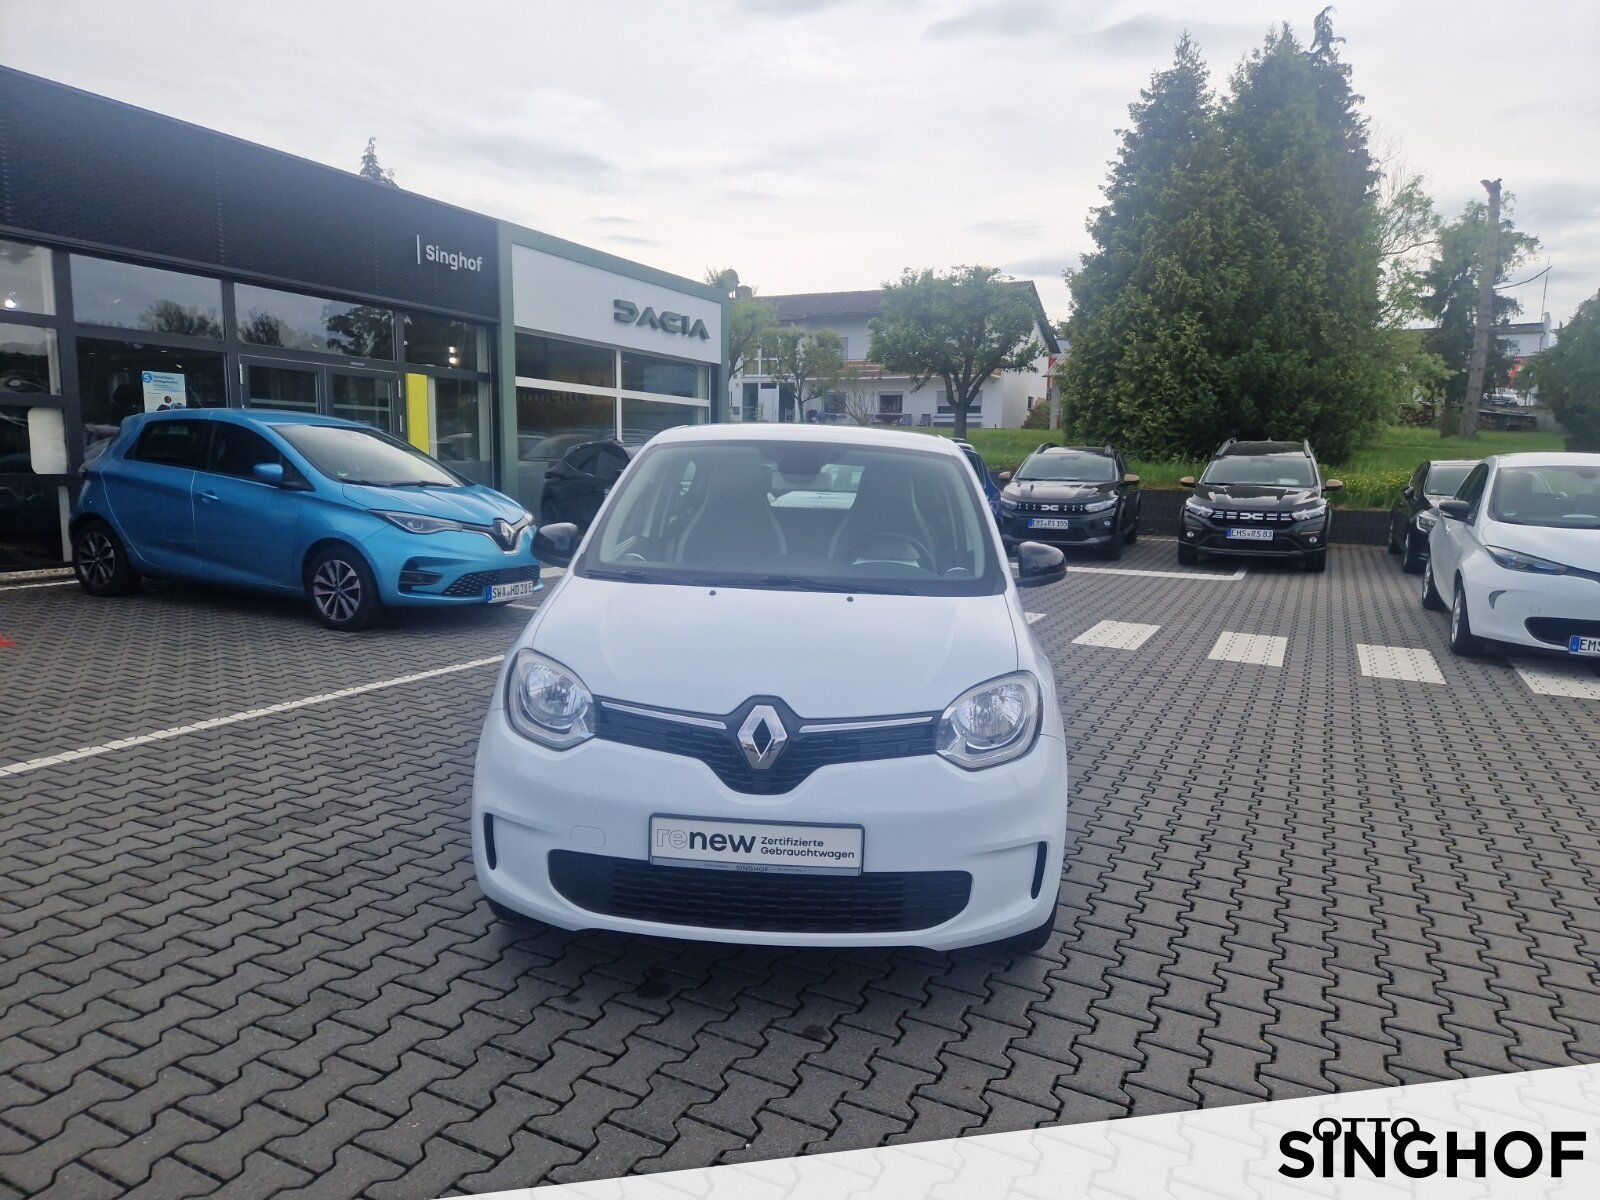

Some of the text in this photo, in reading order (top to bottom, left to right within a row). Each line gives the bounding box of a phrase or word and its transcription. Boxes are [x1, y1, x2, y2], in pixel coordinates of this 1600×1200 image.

[425, 244, 484, 272] Singhof
[613, 298, 711, 340] DACIA
[1231, 529, 1247, 537] EMS
[656, 828, 757, 854] renew
[760, 836, 825, 848] Zertifizierte
[760, 846, 855, 860] Gebrauchtwagen
[736, 864, 769, 873] SINGHOF
